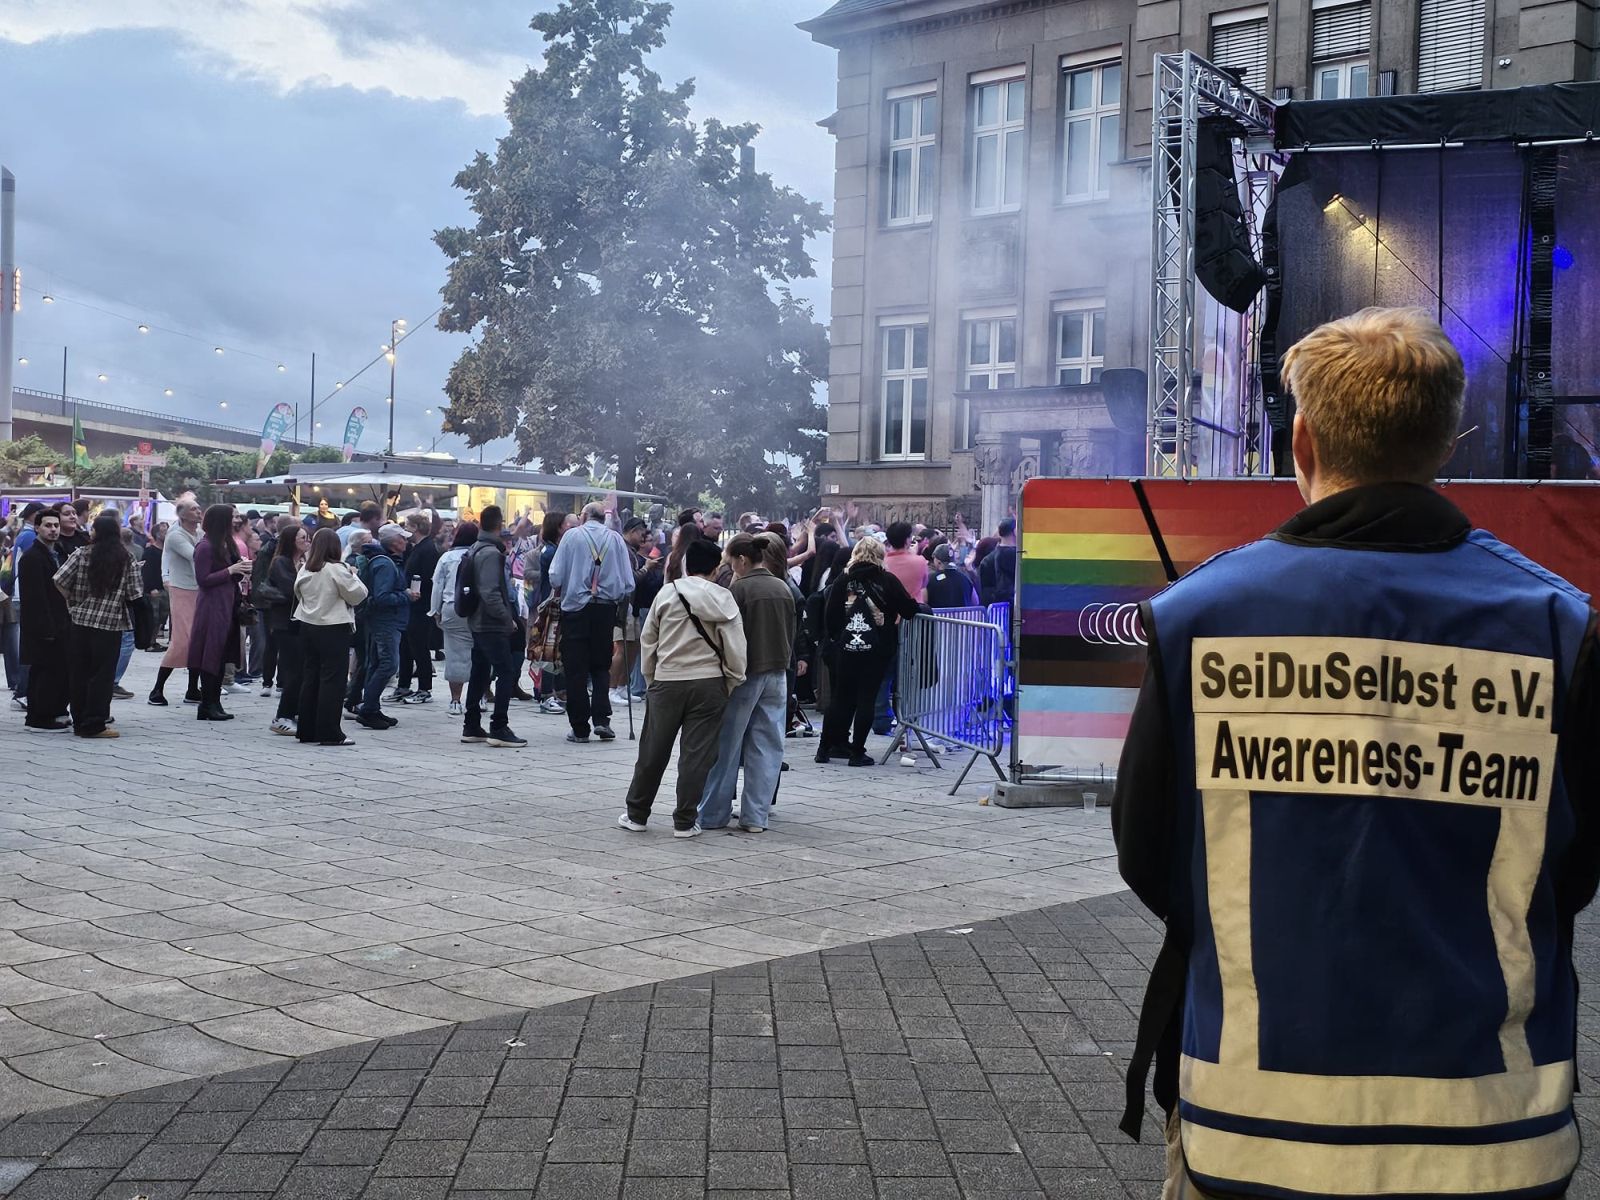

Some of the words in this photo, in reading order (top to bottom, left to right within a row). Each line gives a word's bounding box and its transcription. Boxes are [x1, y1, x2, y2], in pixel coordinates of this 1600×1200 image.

[1200, 651, 1457, 710] SeiDuSelbst
[1472, 668, 1545, 719] e.V.
[1211, 720, 1540, 801] Awareness-Team
